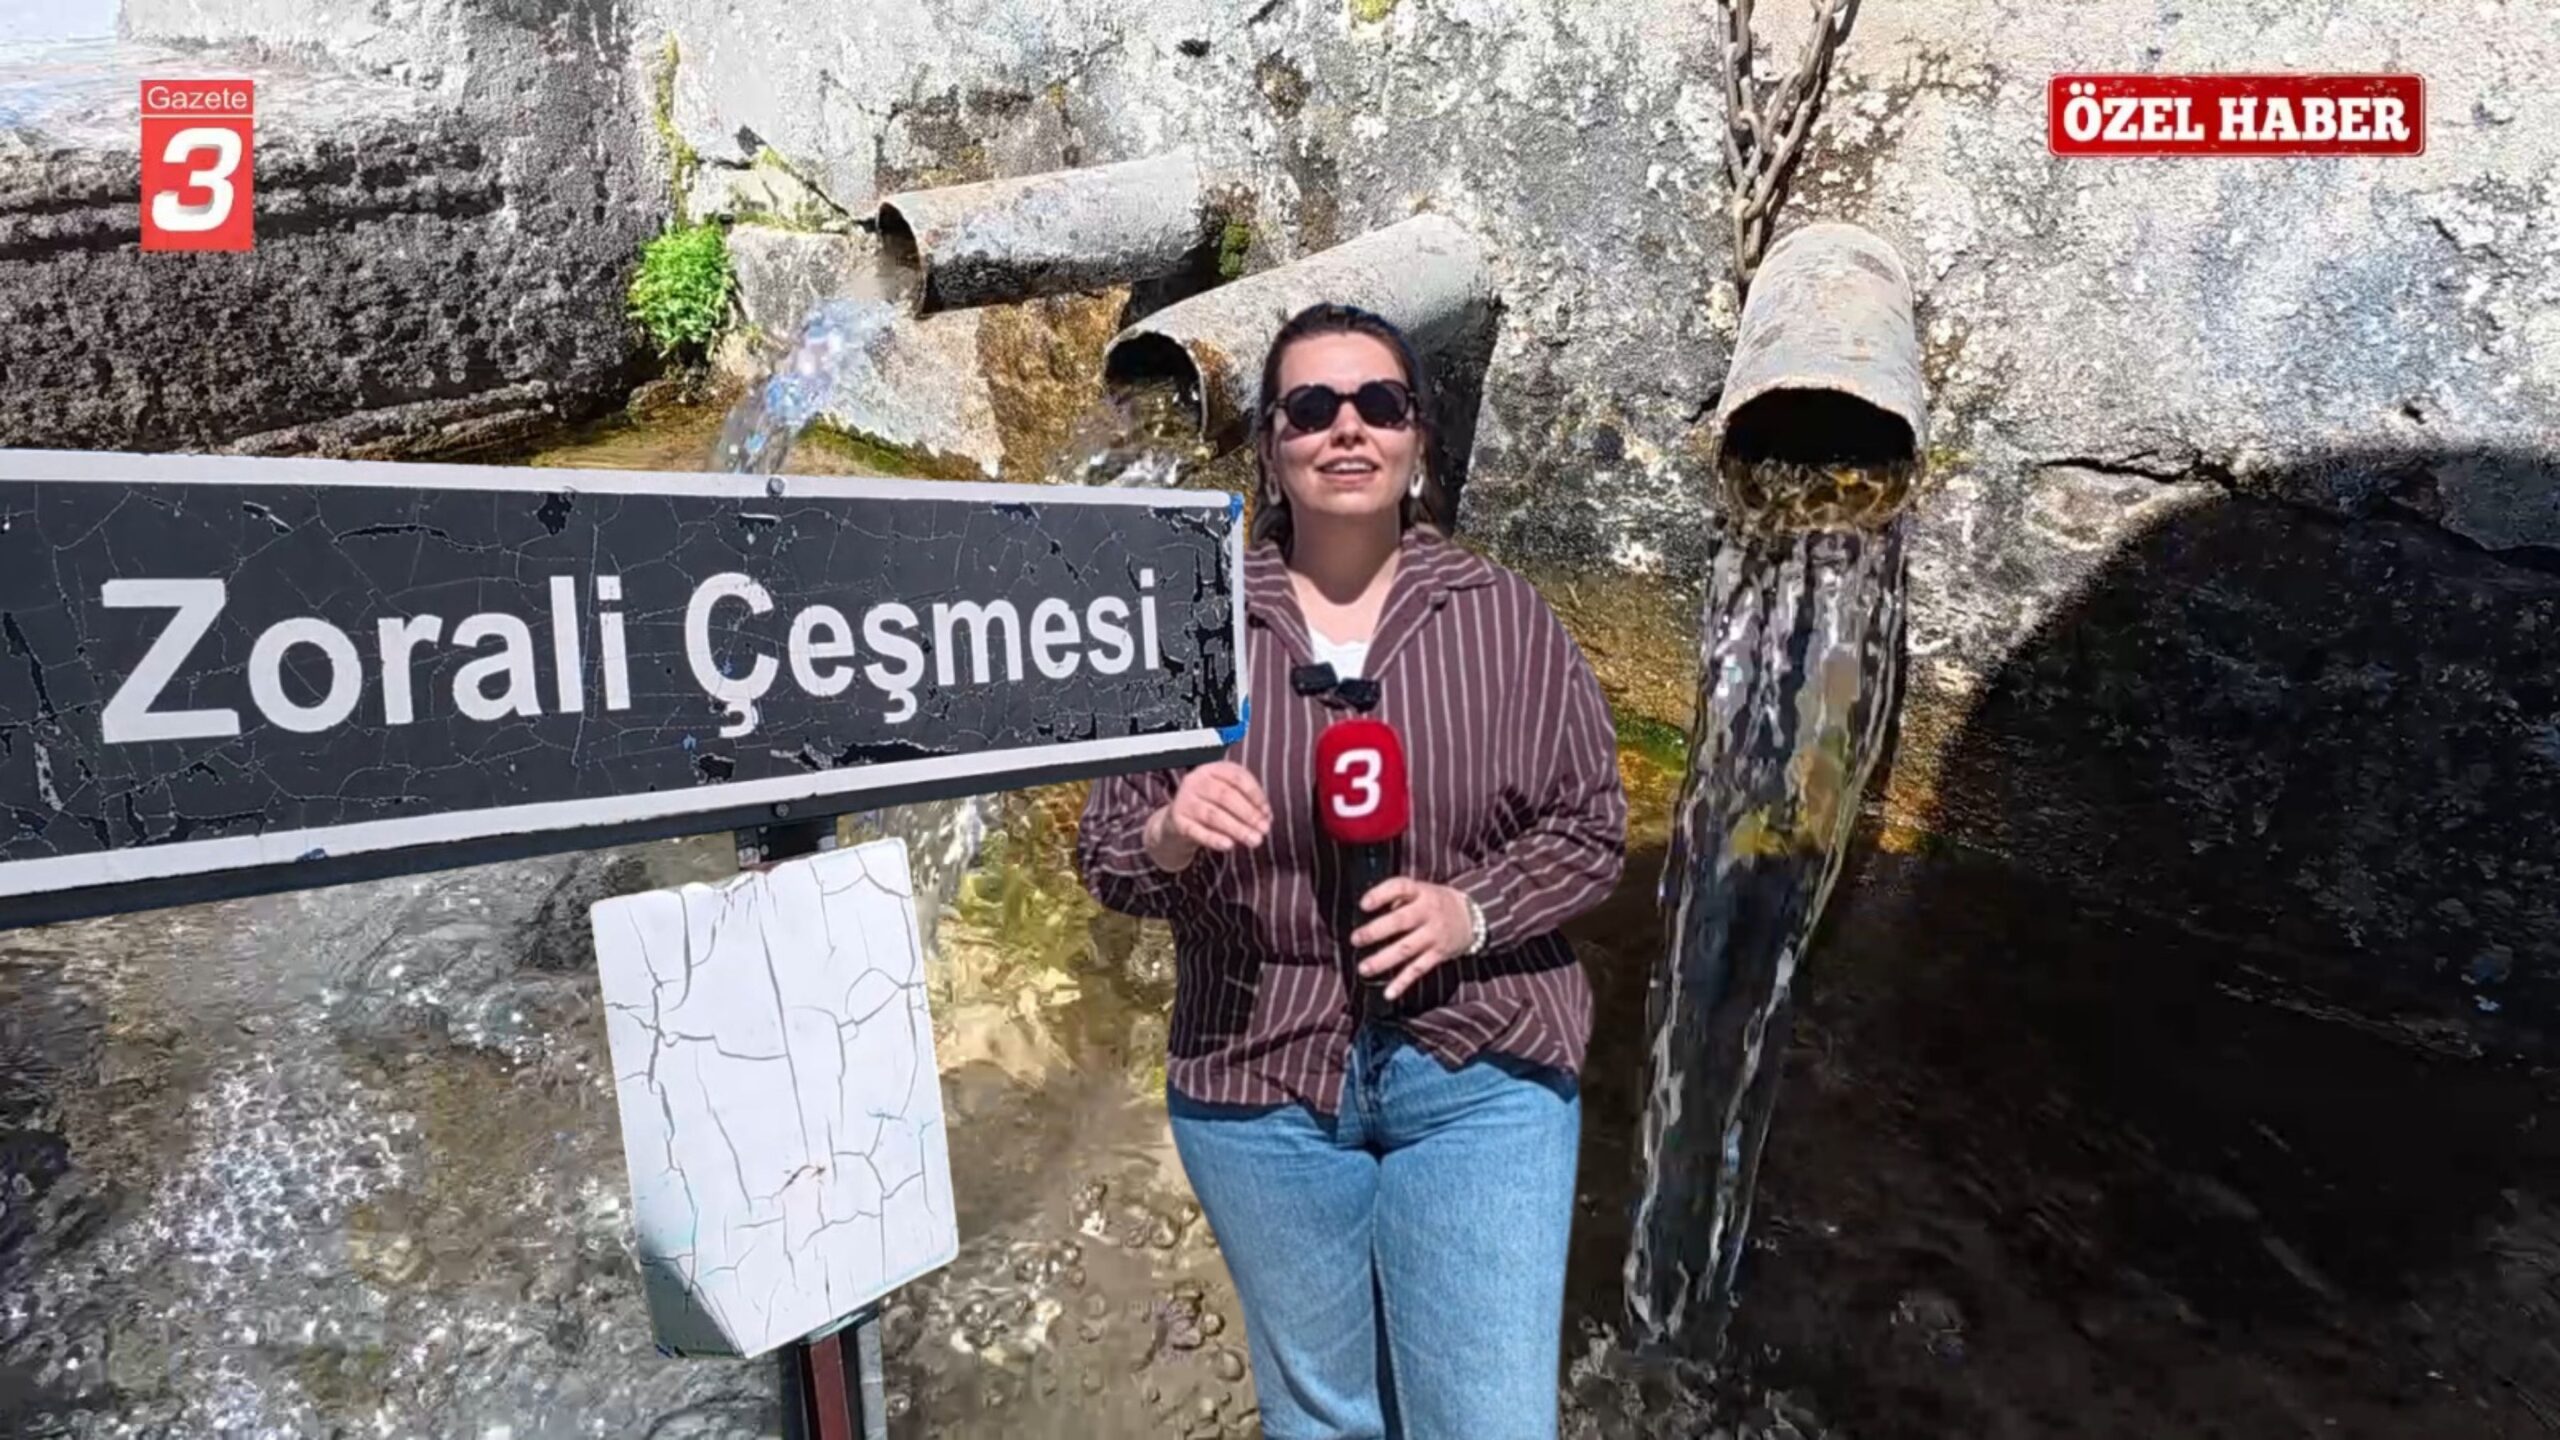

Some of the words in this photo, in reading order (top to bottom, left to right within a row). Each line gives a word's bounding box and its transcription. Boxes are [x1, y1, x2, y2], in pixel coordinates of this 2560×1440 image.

[101, 574, 632, 744] Zorali
[684, 567, 1160, 739] Çeşmesi
[1332, 748, 1382, 818] 3
